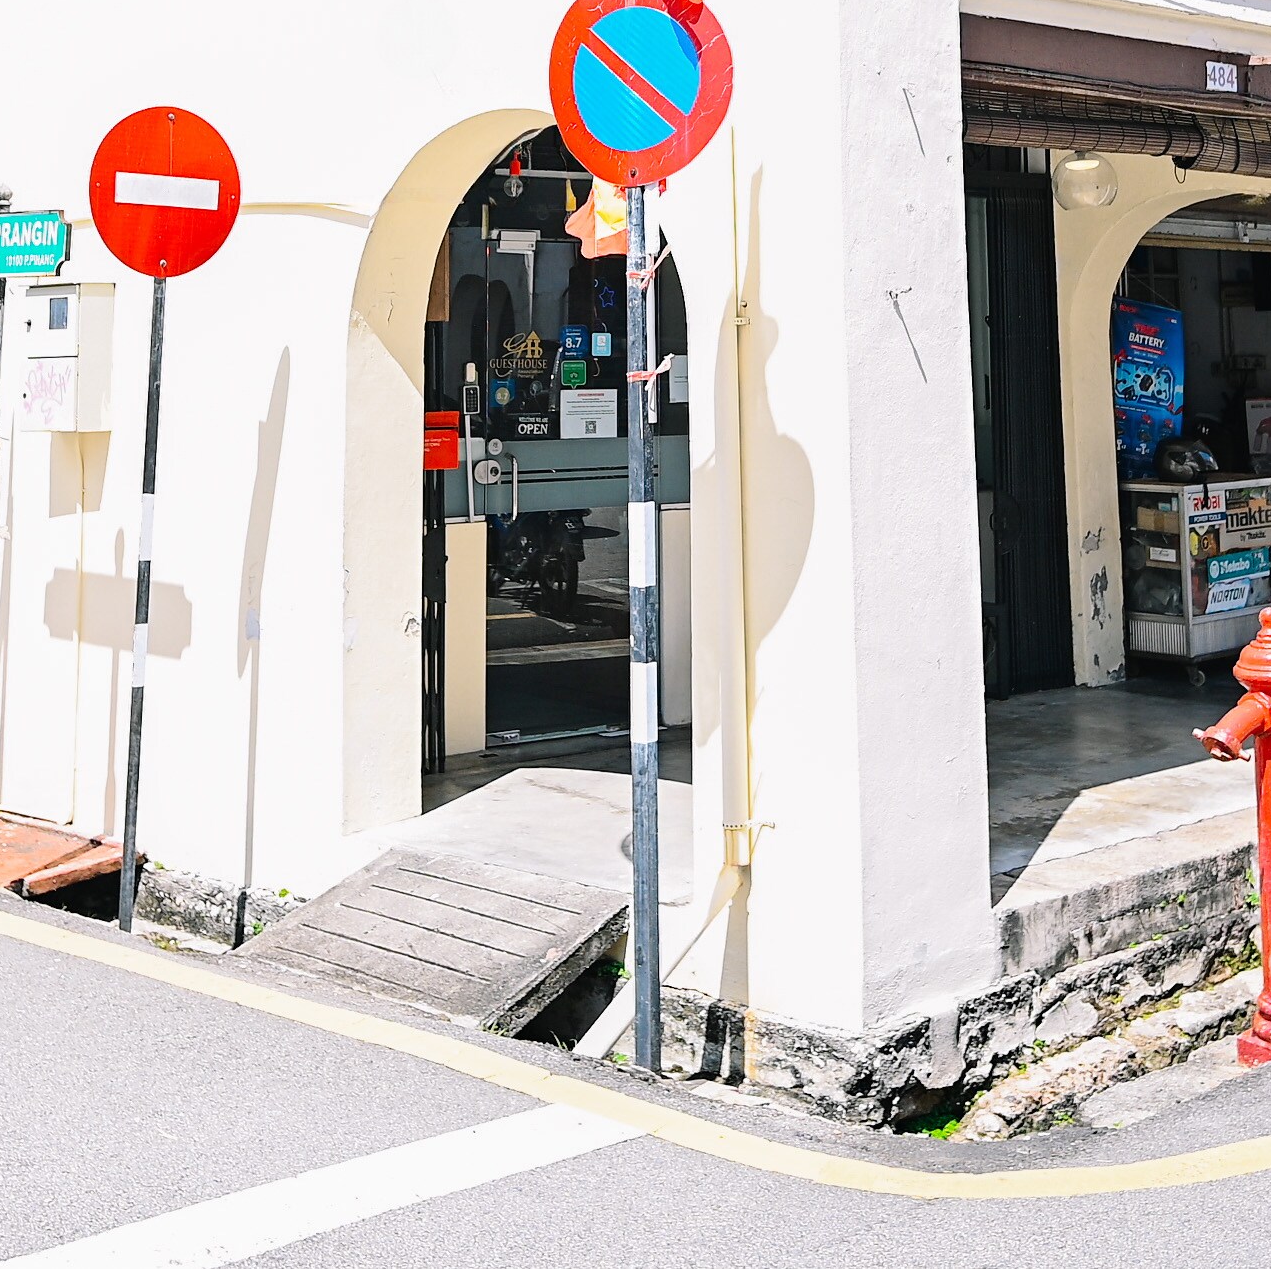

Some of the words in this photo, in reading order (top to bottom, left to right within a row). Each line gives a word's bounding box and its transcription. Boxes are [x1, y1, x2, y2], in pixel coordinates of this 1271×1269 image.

[1209, 65, 1235, 88] 484
[5, 255, 23, 267] 10100
[565, 337, 582, 348] 8.7
[1128, 332, 1165, 348] BATTERY
[489, 358, 548, 369] GUESTHOUSE
[518, 423, 548, 435] OPEN
[1193, 515, 1208, 523] POWER
[1210, 587, 1246, 604] NORTON
